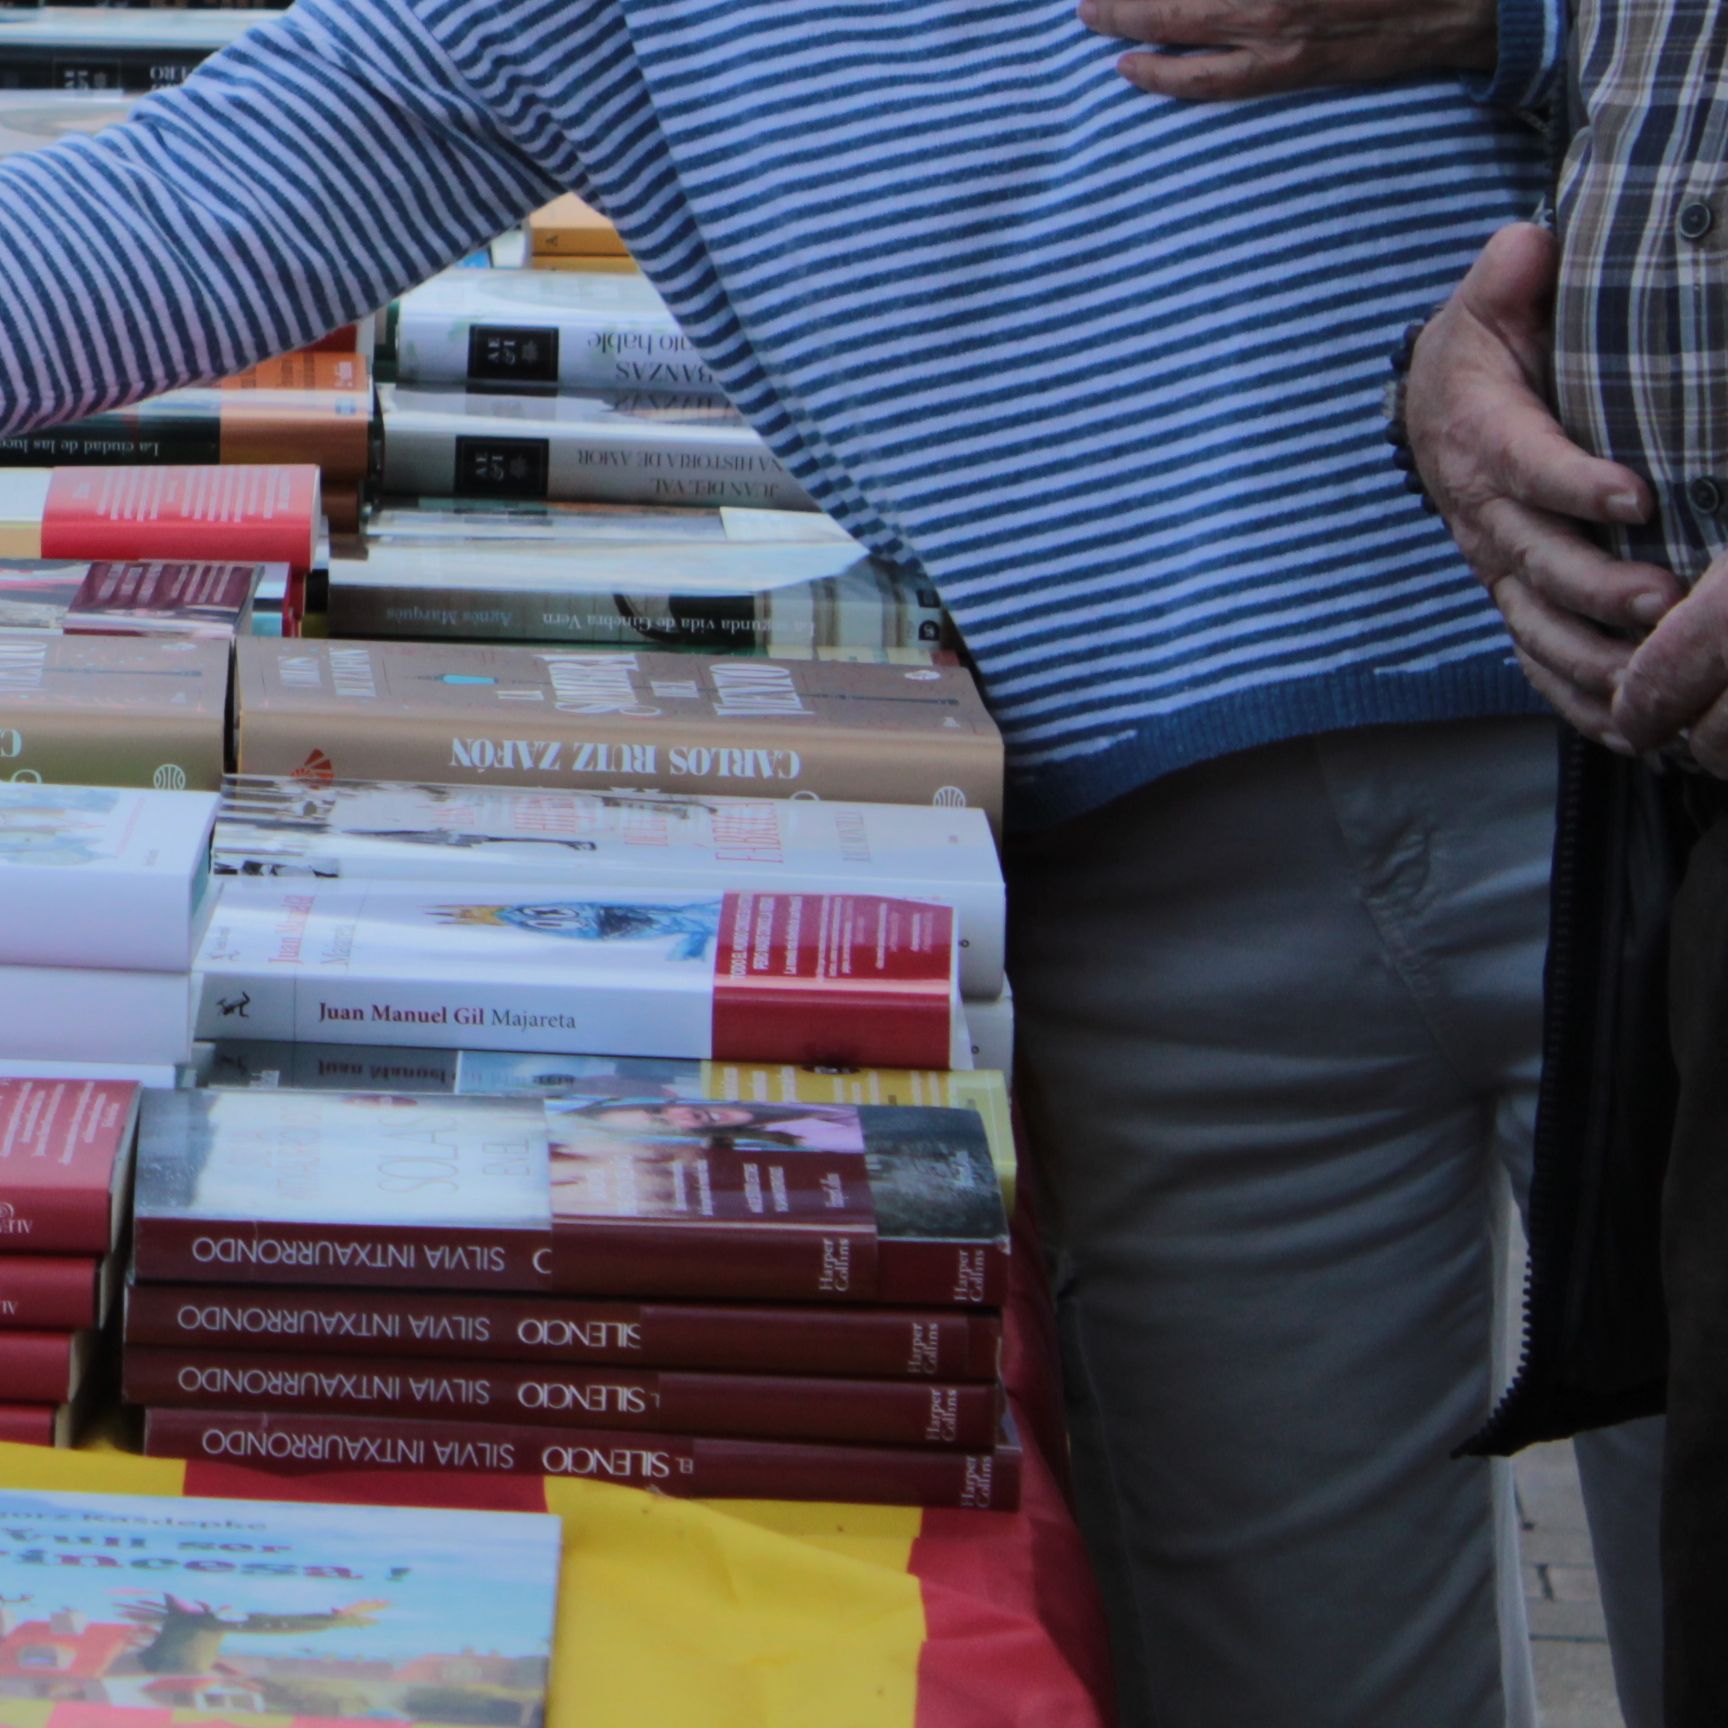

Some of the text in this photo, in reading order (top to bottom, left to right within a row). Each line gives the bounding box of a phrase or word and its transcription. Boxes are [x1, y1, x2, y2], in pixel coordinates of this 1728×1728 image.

[587, 332, 652, 356] hable
[61, 435, 82, 454] de
[85, 435, 136, 456] ciudad
[140, 438, 161, 456] La
[577, 448, 632, 467] AMOR
[541, 611, 581, 629] Vern
[586, 613, 652, 632] Ginebra
[680, 615, 716, 634] vida
[449, 737, 802, 778] CARLOS RUIZ ZAFÓN
[318, 1001, 577, 1033] Juan Manuel Gil Majareta
[191, 1235, 506, 1273] SILVIA INTXAURRONDO
[818, 1236, 835, 1293] Harper
[835, 1236, 851, 1293] Collins
[954, 1248, 971, 1303] Harper
[970, 1248, 986, 1303] Collins
[176, 1303, 643, 1349] SILENCIO SILVIA INTXAURRONDO
[176, 1365, 646, 1413] SILENCIO SILVIA INTXAURRONDO
[201, 1427, 671, 1478] SILENCIO SILVIA INTXAURRONDO
